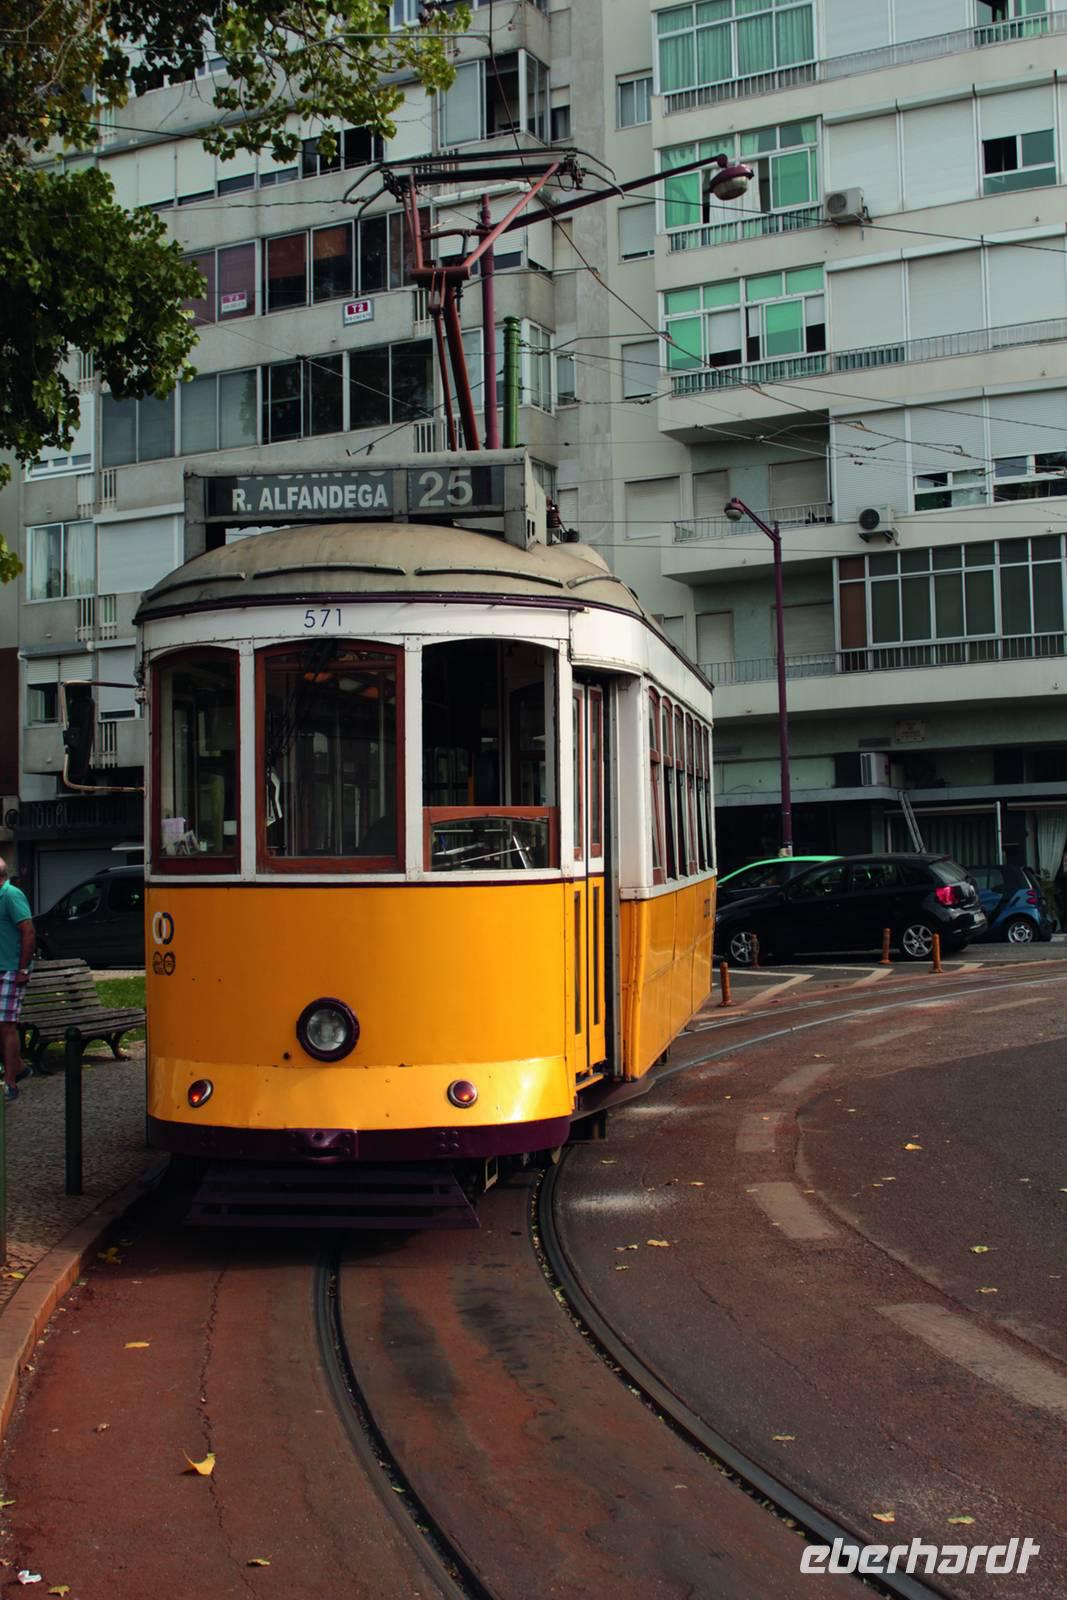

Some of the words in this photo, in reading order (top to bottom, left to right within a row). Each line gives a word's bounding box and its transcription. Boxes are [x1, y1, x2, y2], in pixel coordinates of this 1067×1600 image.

[232, 488, 252, 511] R.
[258, 484, 389, 510] ALFANDEGA
[418, 468, 473, 507] 25
[303, 608, 342, 628] 571
